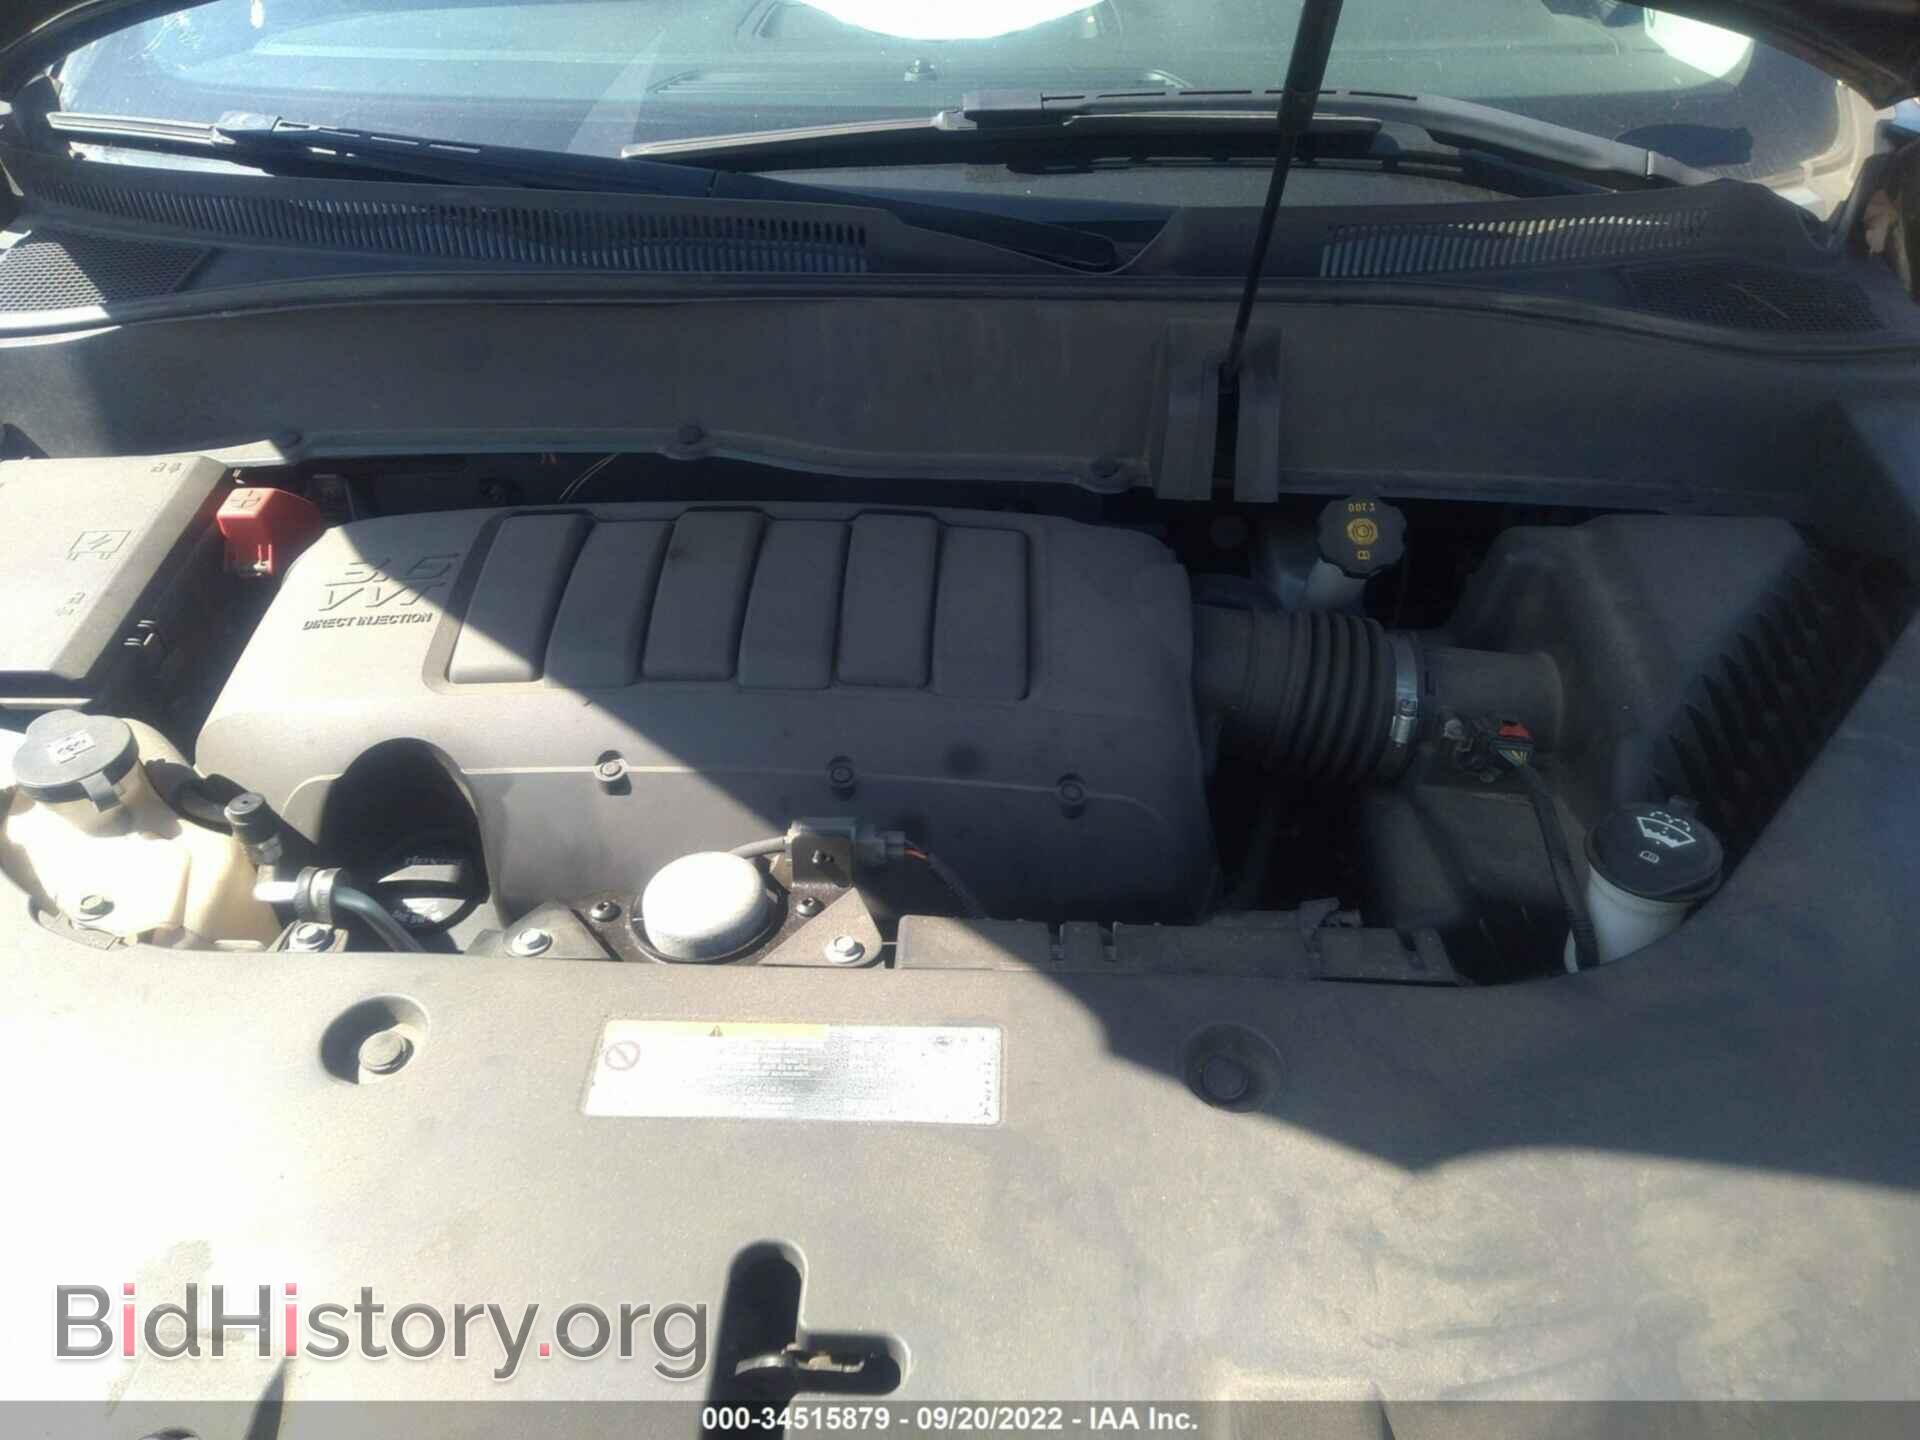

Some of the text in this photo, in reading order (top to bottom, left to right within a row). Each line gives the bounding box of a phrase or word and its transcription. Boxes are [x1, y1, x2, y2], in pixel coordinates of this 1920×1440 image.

[318, 580, 448, 612] VVT
[302, 612, 434, 631] DIRECT INJECTION
